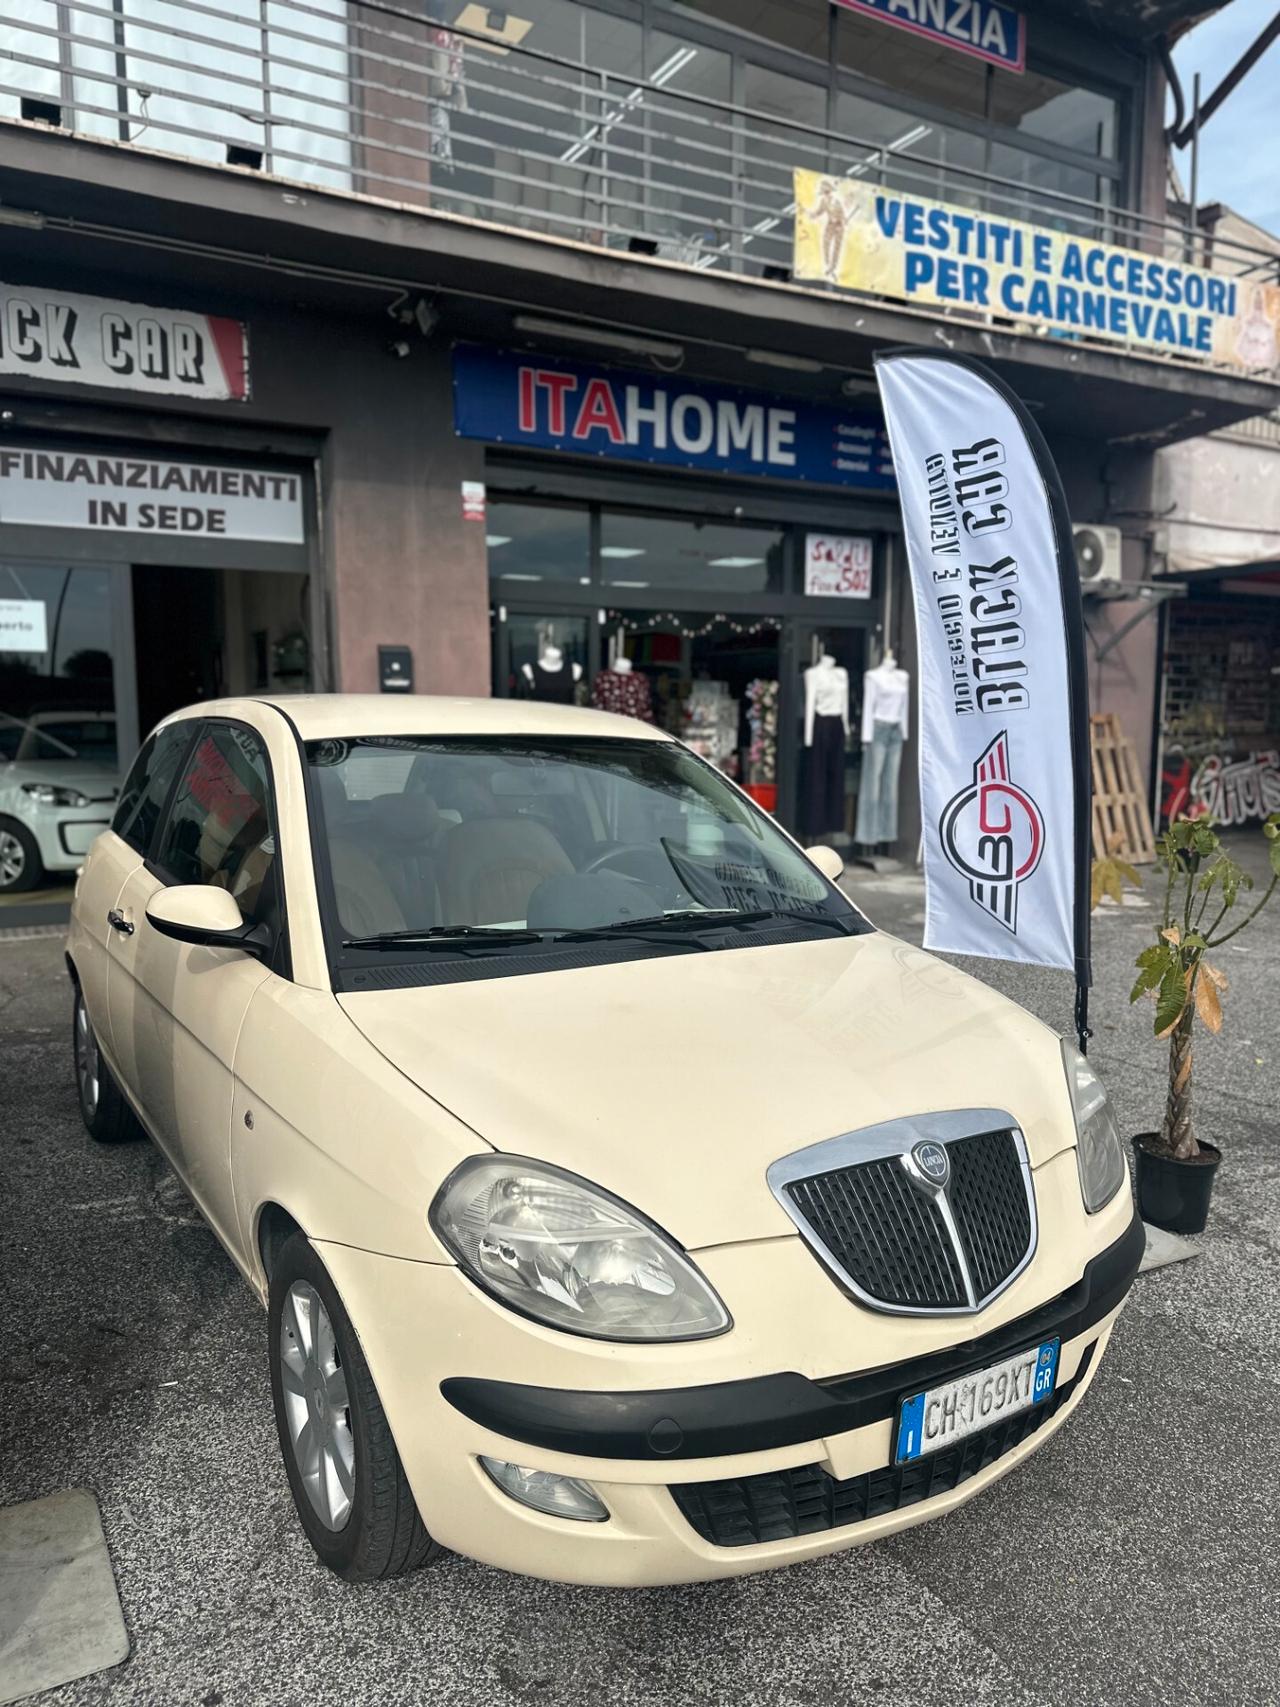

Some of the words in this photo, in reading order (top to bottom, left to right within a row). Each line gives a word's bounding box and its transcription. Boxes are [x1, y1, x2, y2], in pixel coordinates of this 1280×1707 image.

[875, 197, 1022, 267] VESTITI
[1033, 234, 1052, 274] E
[1061, 243, 1236, 317] ACCESSORI
[0, 297, 80, 369] CK
[101, 312, 205, 385] CAR
[904, 251, 989, 305] PER
[1001, 273, 1213, 352] CARNEVALE
[518, 366, 797, 466] ITAHOME
[0, 450, 297, 502] FINANZIAMENTI
[88, 500, 127, 527] IN
[138, 503, 226, 533] SEDE
[1036, 1367, 1052, 1391] GR
